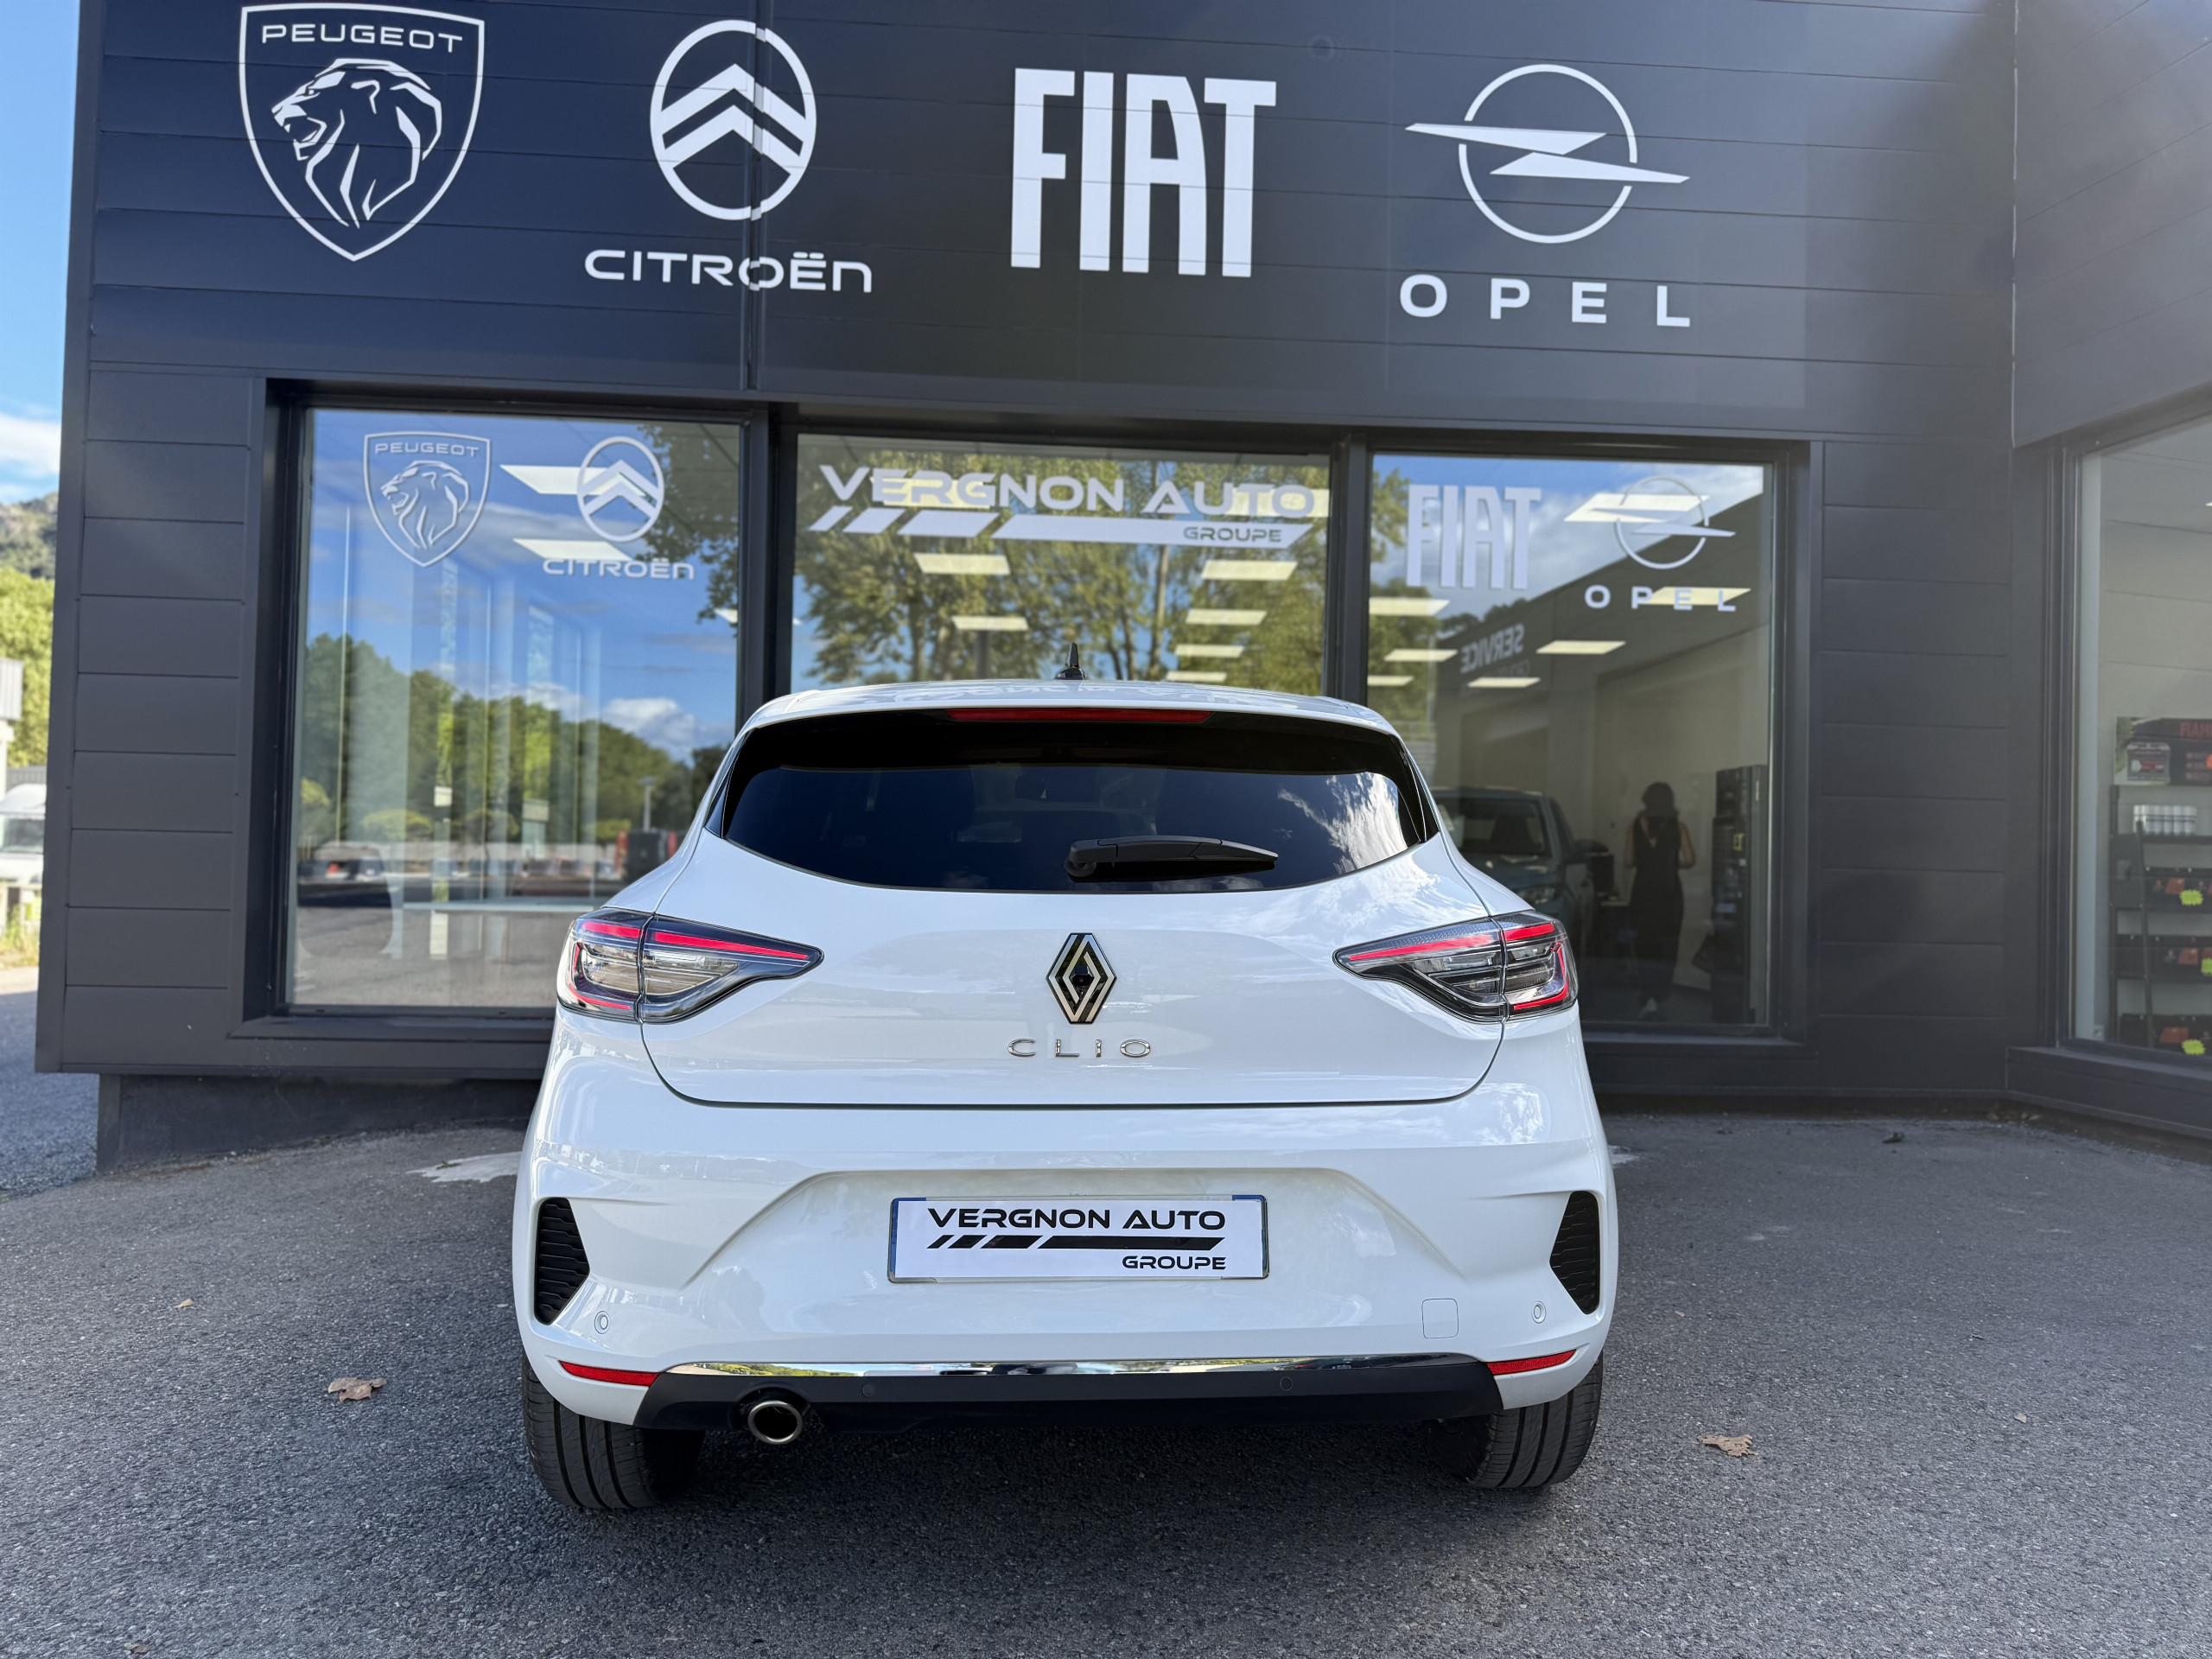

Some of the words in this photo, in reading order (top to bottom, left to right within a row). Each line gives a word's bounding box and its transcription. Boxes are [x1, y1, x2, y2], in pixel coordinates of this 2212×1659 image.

[262, 23, 463, 54] PEUGEOT
[1011, 67, 1277, 277] FIAT
[1400, 274, 1691, 327] OPEL
[374, 442, 480, 458] PEUGEOT
[819, 464, 1124, 512] VERGNON
[1141, 480, 1315, 518] AUTO
[1183, 526, 1282, 543] GROUPE
[1407, 485, 1541, 589] FIAT
[1585, 584, 1737, 612] OPEL
[1007, 1039, 1151, 1058] CLIO
[927, 1208, 1110, 1229] VERGNON
[1122, 1210, 1226, 1230] AUTO
[1122, 1255, 1227, 1271] GROUPE
